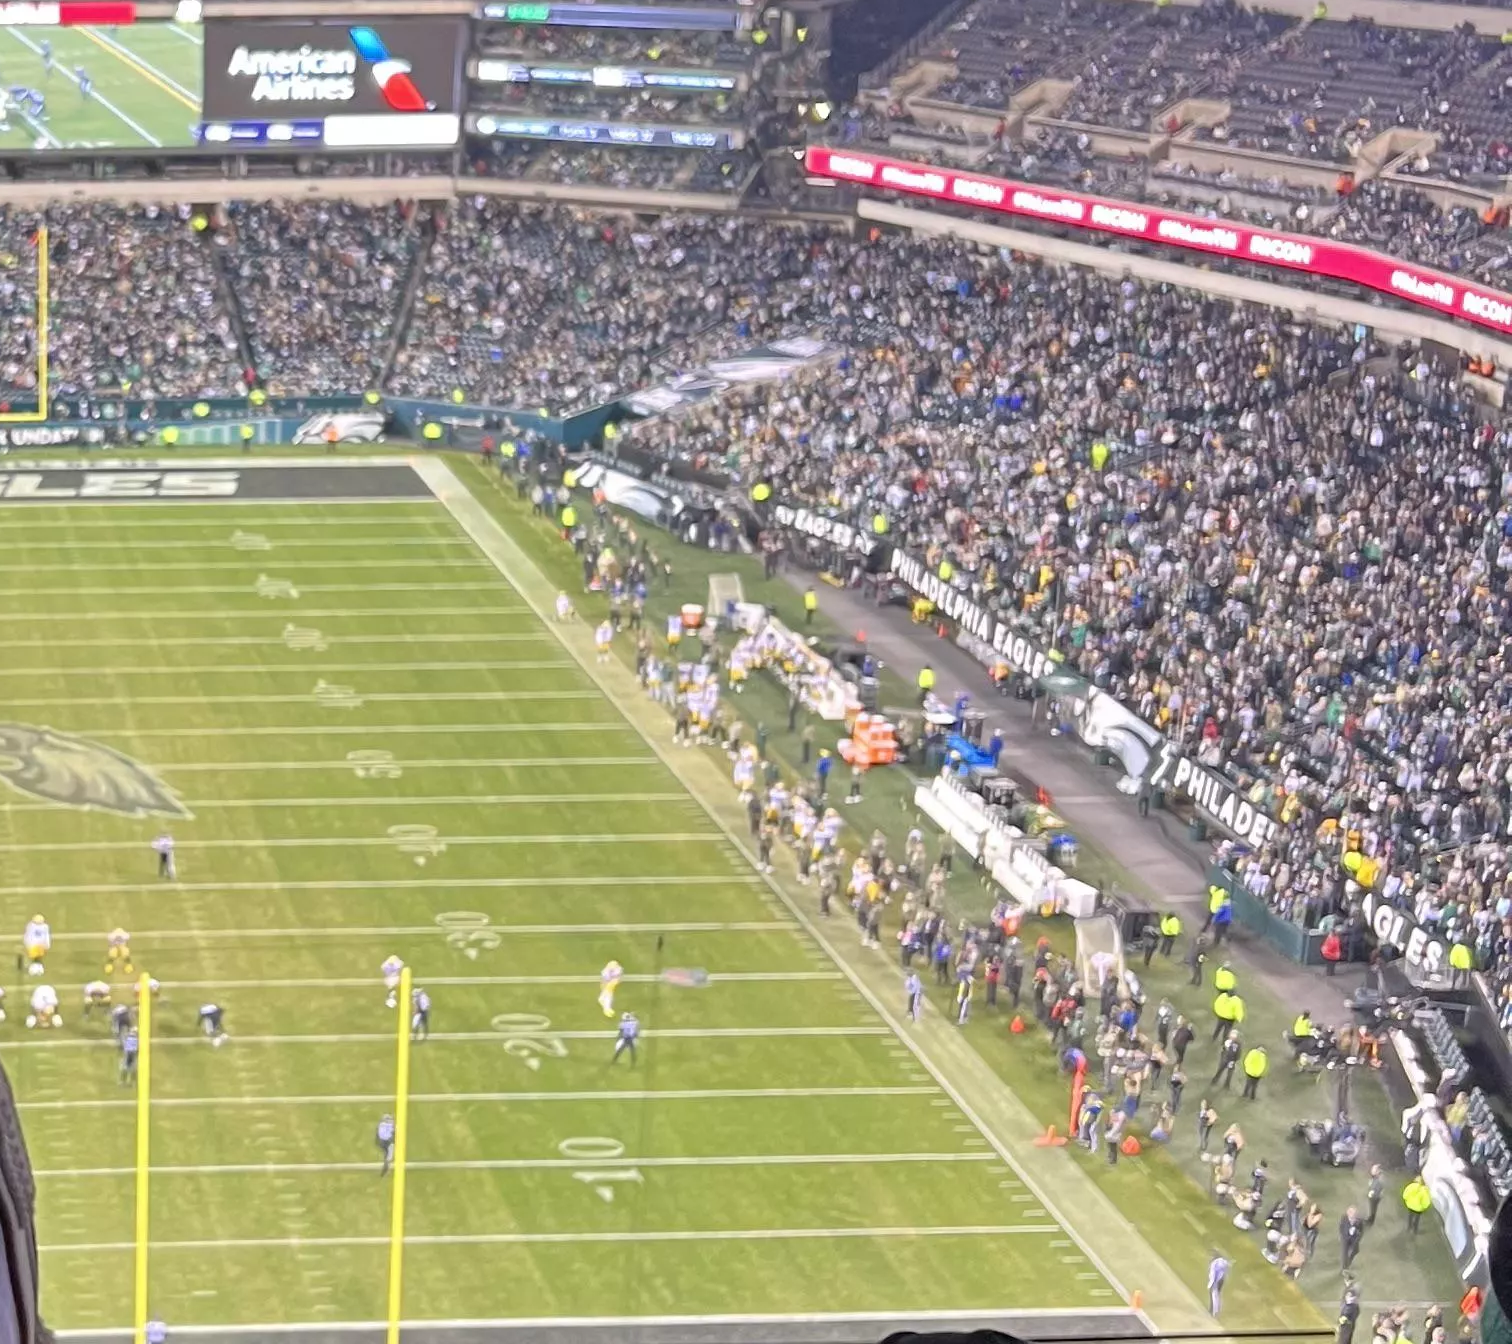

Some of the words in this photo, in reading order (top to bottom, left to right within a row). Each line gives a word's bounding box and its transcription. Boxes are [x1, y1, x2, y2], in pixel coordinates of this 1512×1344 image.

[228, 45, 356, 76] American
[251, 75, 355, 101] Airlines
[1250, 235, 1311, 264] RICOH
[890, 547, 988, 642] PHILADELPHIA
[1174, 756, 1279, 849] PHILADE
[435, 911, 502, 949] 30
[490, 1013, 569, 1057] 20
[558, 1136, 645, 1185] 10
